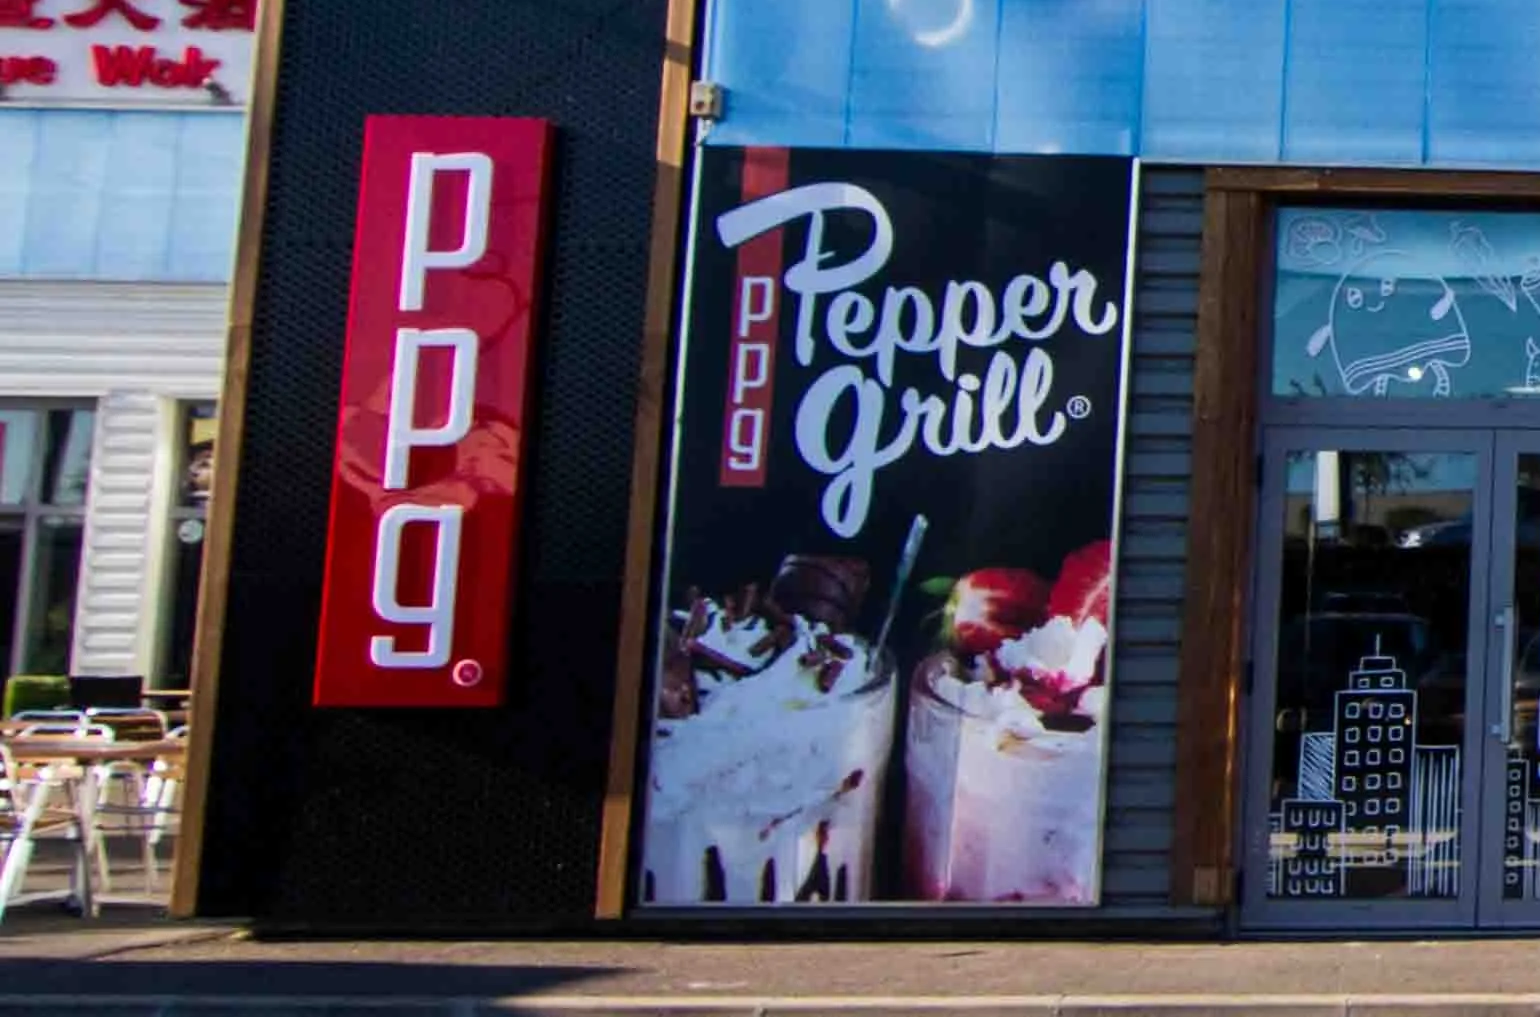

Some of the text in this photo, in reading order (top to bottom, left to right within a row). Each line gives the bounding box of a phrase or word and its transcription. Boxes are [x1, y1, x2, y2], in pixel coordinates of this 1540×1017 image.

[716, 182, 1117, 387] Pepper
[728, 276, 774, 471] ppg
[370, 151, 494, 669] ppg
